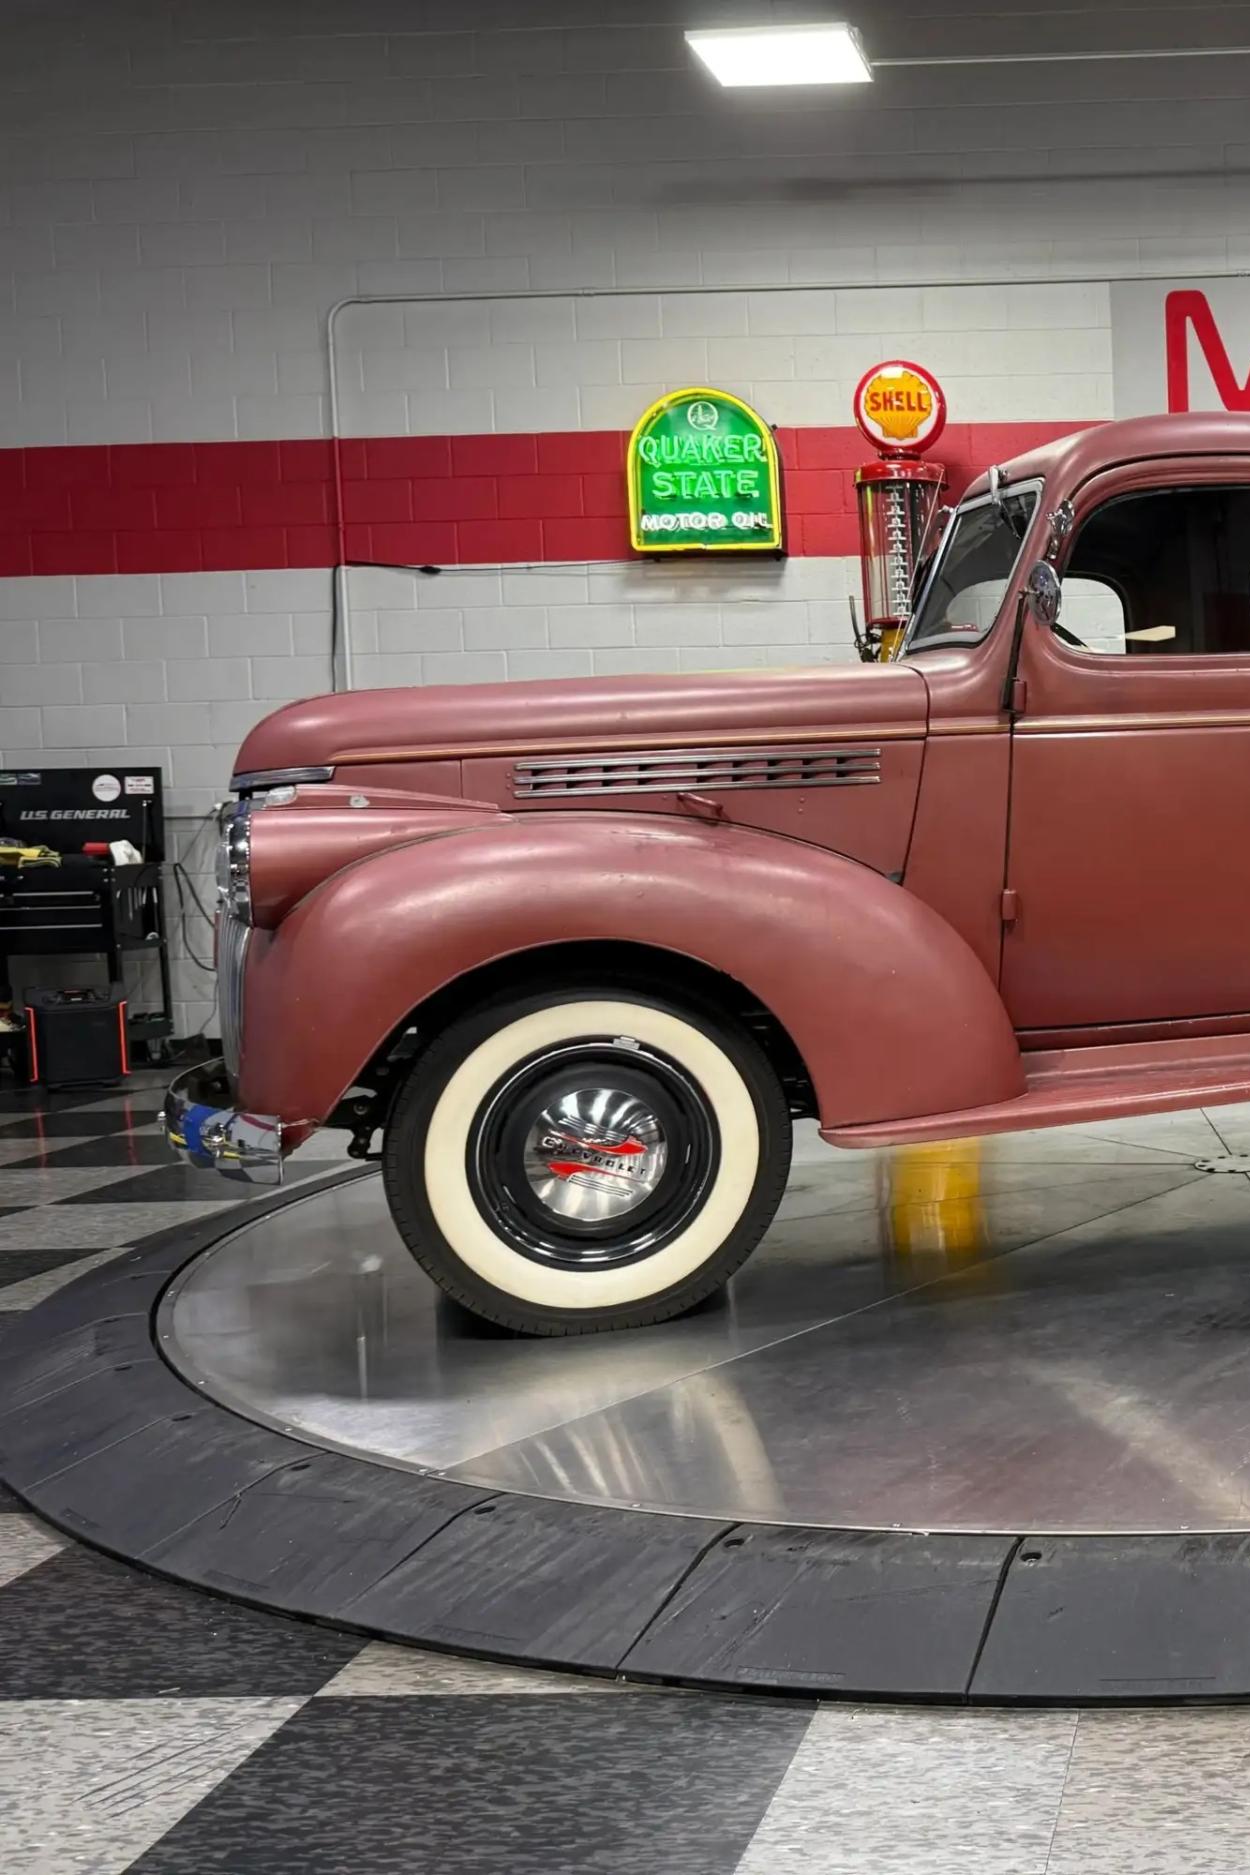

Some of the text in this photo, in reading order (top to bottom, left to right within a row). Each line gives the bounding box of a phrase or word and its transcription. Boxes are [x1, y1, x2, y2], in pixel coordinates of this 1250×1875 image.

[869, 391, 928, 412] SHELL
[638, 433, 768, 468] QUAKER
[651, 470, 760, 499] STATE
[640, 511, 774, 532] MOTOR OIL
[49, 808, 132, 820] GENERAL
